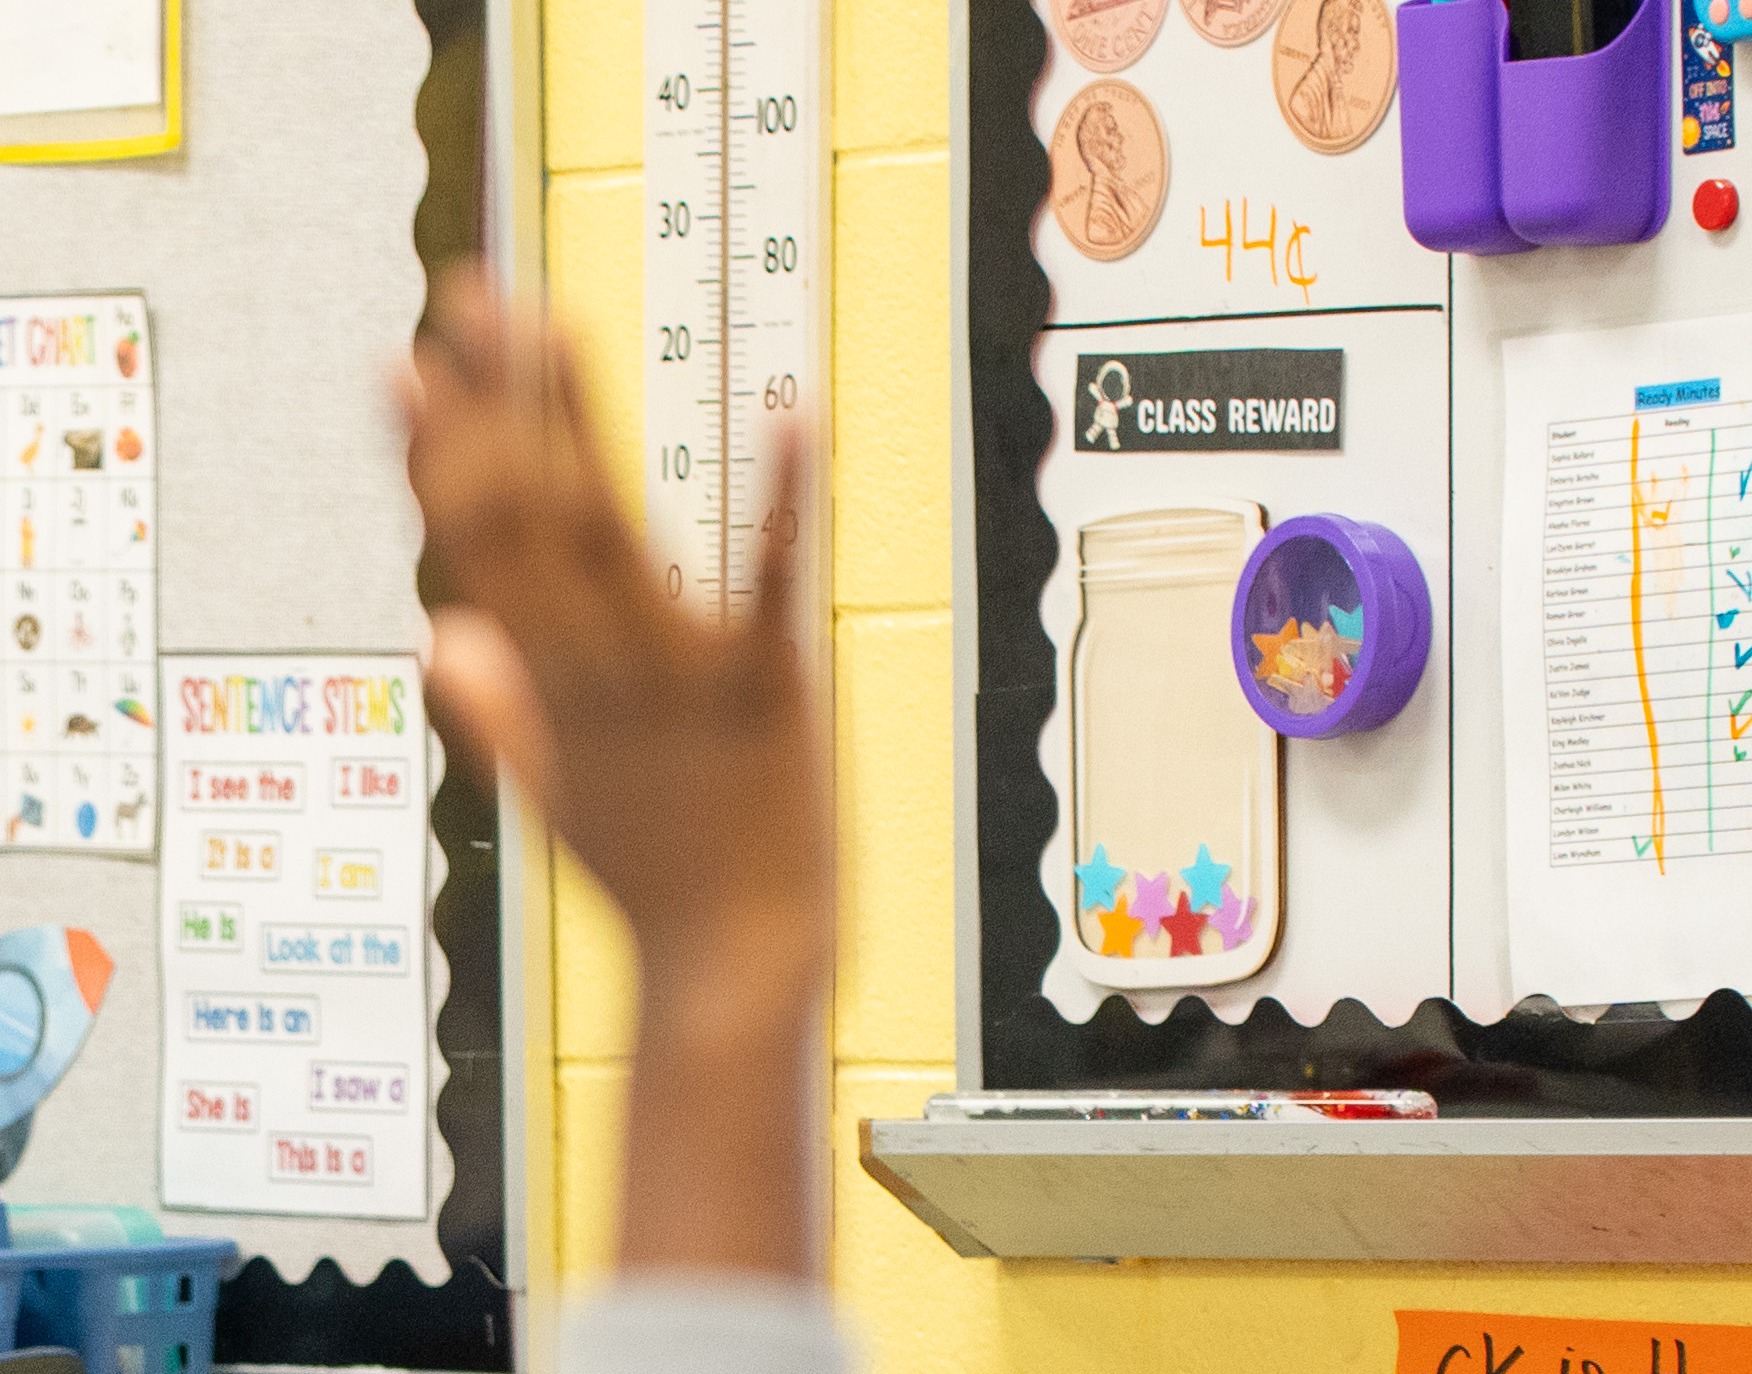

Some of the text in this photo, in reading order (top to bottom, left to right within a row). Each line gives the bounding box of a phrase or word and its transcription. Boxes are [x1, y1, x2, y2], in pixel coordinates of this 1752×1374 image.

[657, 73, 690, 111] 40
[756, 95, 797, 134] 100
[658, 201, 690, 238] 30
[763, 236, 797, 273] 80
[25, 315, 97, 368] CHART
[659, 325, 690, 362] 20
[763, 373, 797, 410] 60
[1636, 387, 1721, 407] Ready Minutes
[1137, 398, 1336, 434] CLASS REWARD
[661, 444, 690, 480] 10
[180, 675, 406, 735] SENTENCE STEMS
[190, 769, 296, 802] I see the
[339, 764, 400, 797] I like
[319, 856, 377, 891] I am
[266, 932, 402, 966] Look at the
[194, 1004, 311, 1035] Here is an
[313, 1068, 405, 1102] I saw a
[276, 1140, 365, 1174] This is a
